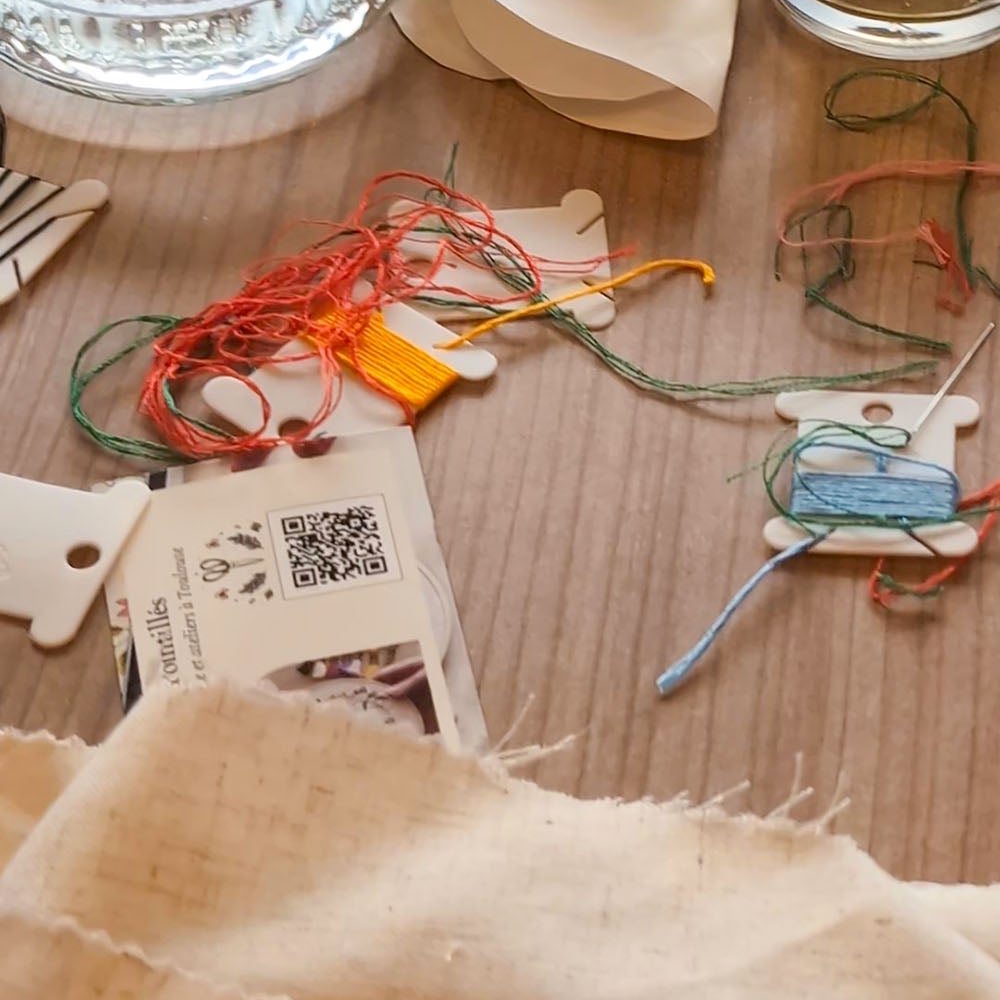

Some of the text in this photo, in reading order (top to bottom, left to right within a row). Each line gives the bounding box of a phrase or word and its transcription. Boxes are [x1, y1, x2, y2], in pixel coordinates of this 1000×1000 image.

[171, 547, 192, 600] Toulouse
[178, 601, 194, 610] à
[183, 612, 203, 658] ateliers
